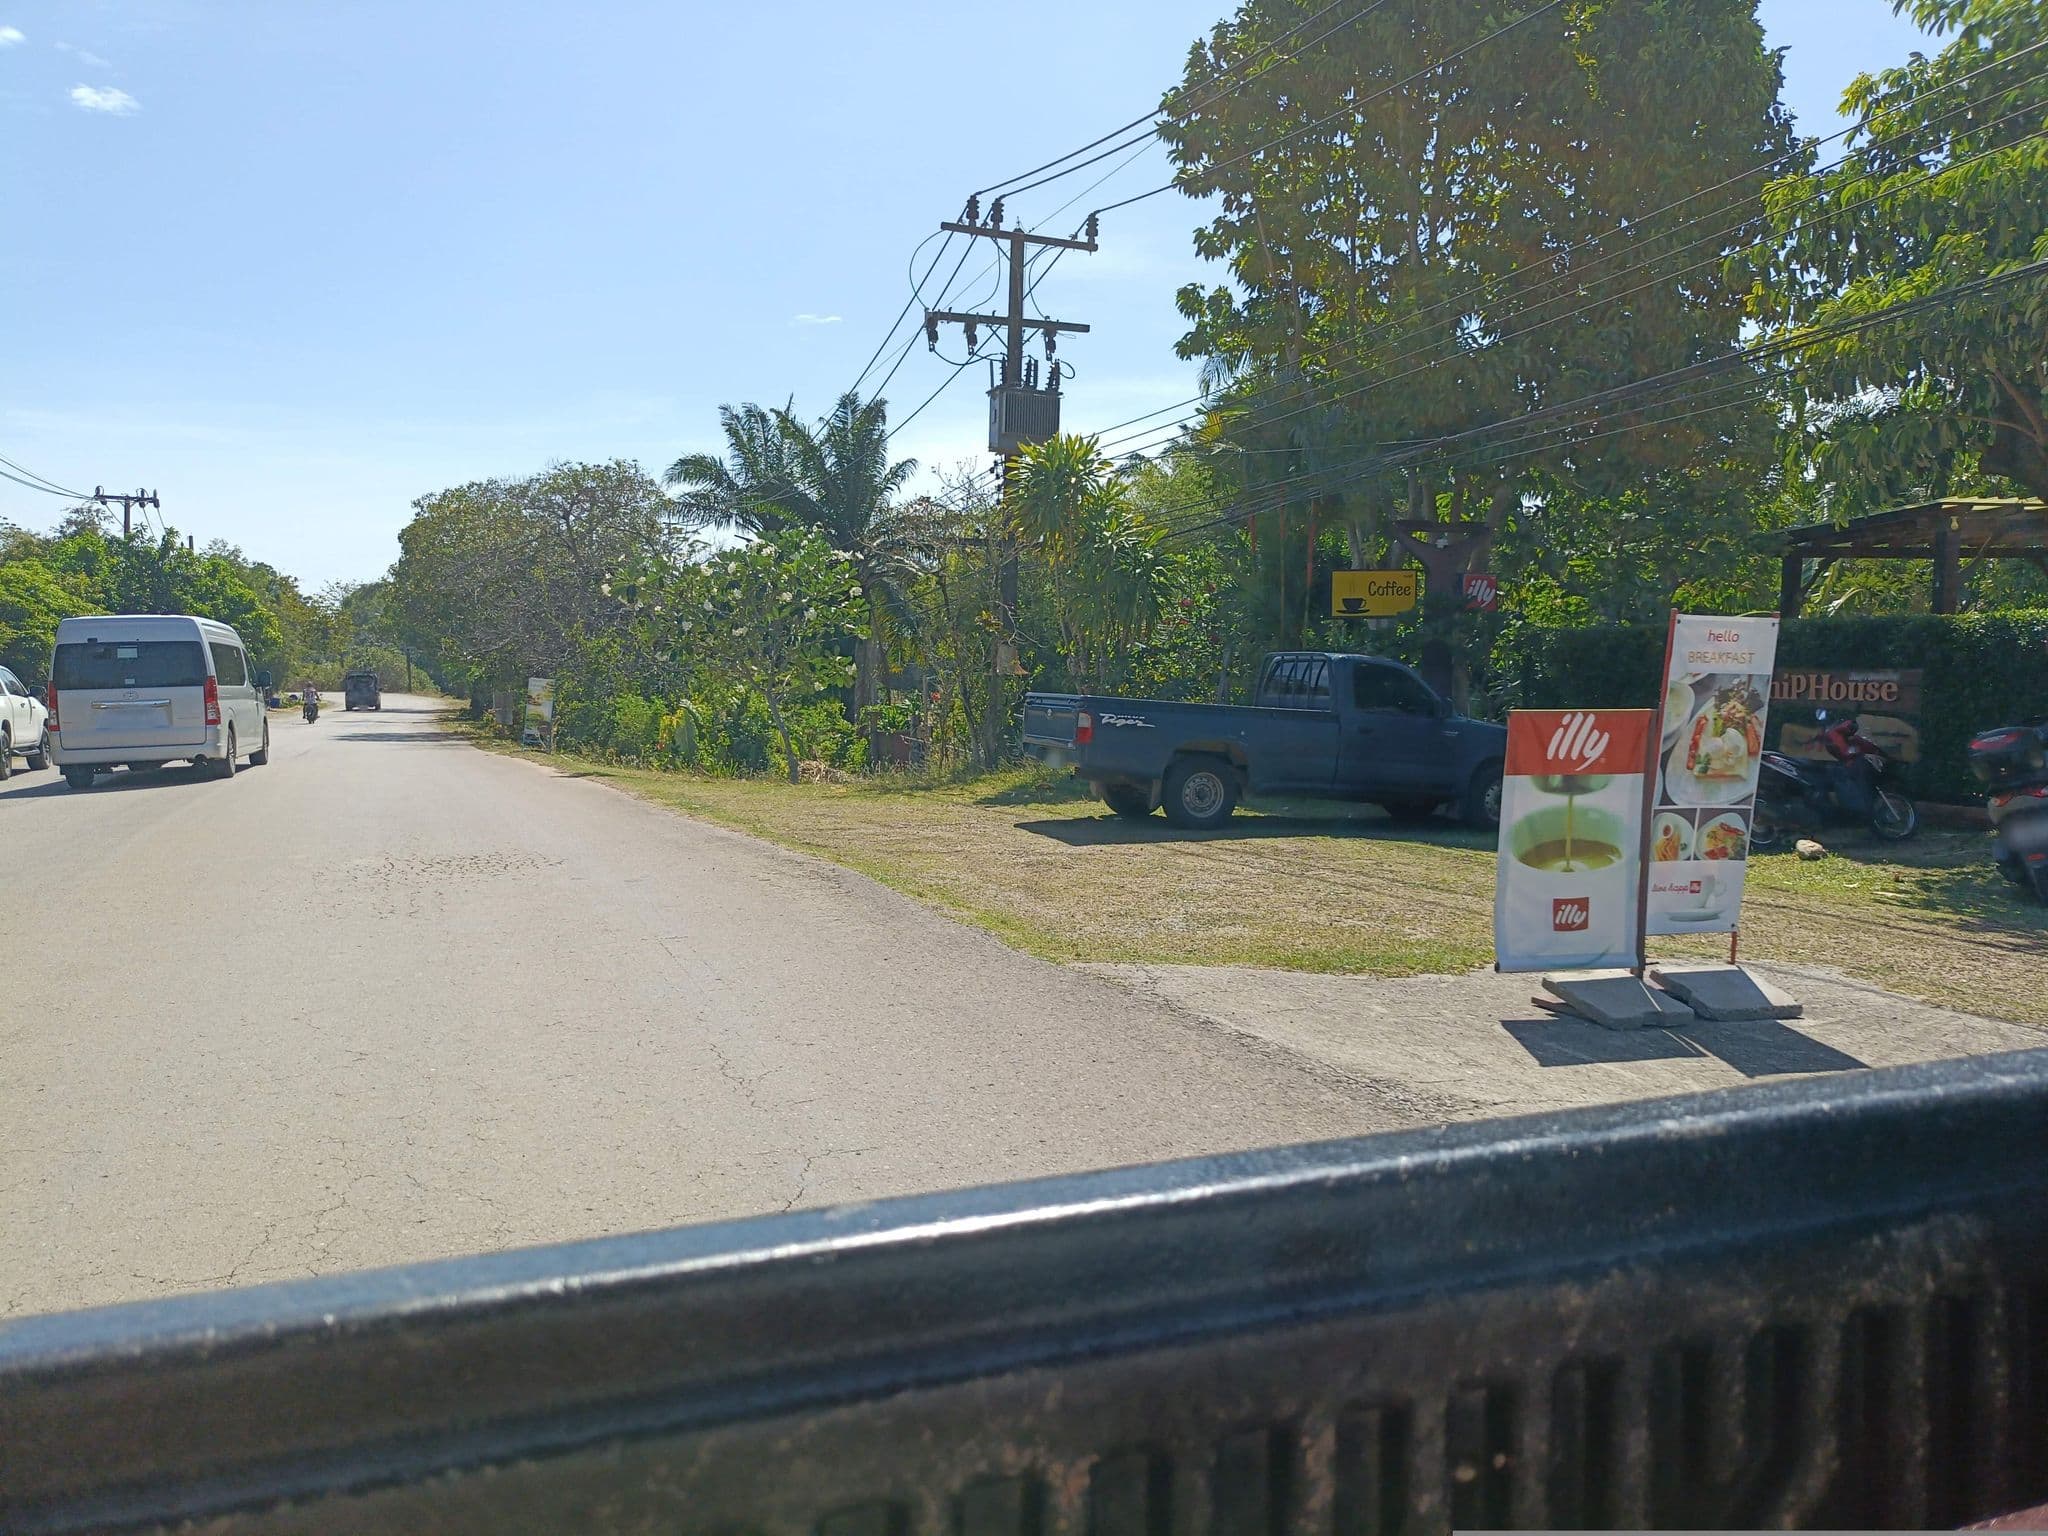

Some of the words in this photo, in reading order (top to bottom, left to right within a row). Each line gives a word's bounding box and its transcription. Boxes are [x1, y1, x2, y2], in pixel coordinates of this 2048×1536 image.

[1368, 580, 1412, 597] Coffee
[1467, 579, 1496, 607] illy
[1707, 629, 1740, 643] hello
[1687, 650, 1757, 665] BREAKFAST
[1546, 711, 1610, 772] illy
[1555, 903, 1587, 929] illy
